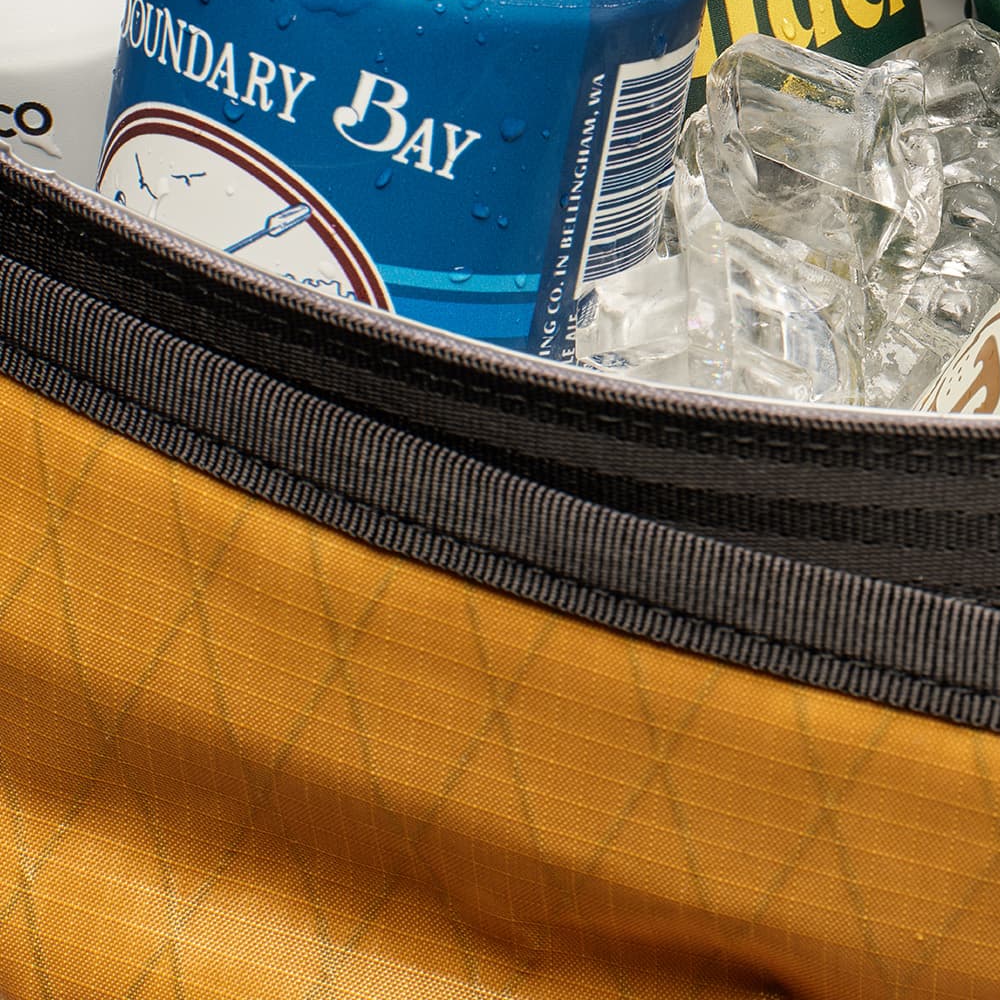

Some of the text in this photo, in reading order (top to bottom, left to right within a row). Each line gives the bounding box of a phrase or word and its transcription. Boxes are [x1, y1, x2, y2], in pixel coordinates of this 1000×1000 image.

[588, 73, 606, 106] WA
[553, 255, 570, 277] IN
[547, 281, 564, 314] CO.
